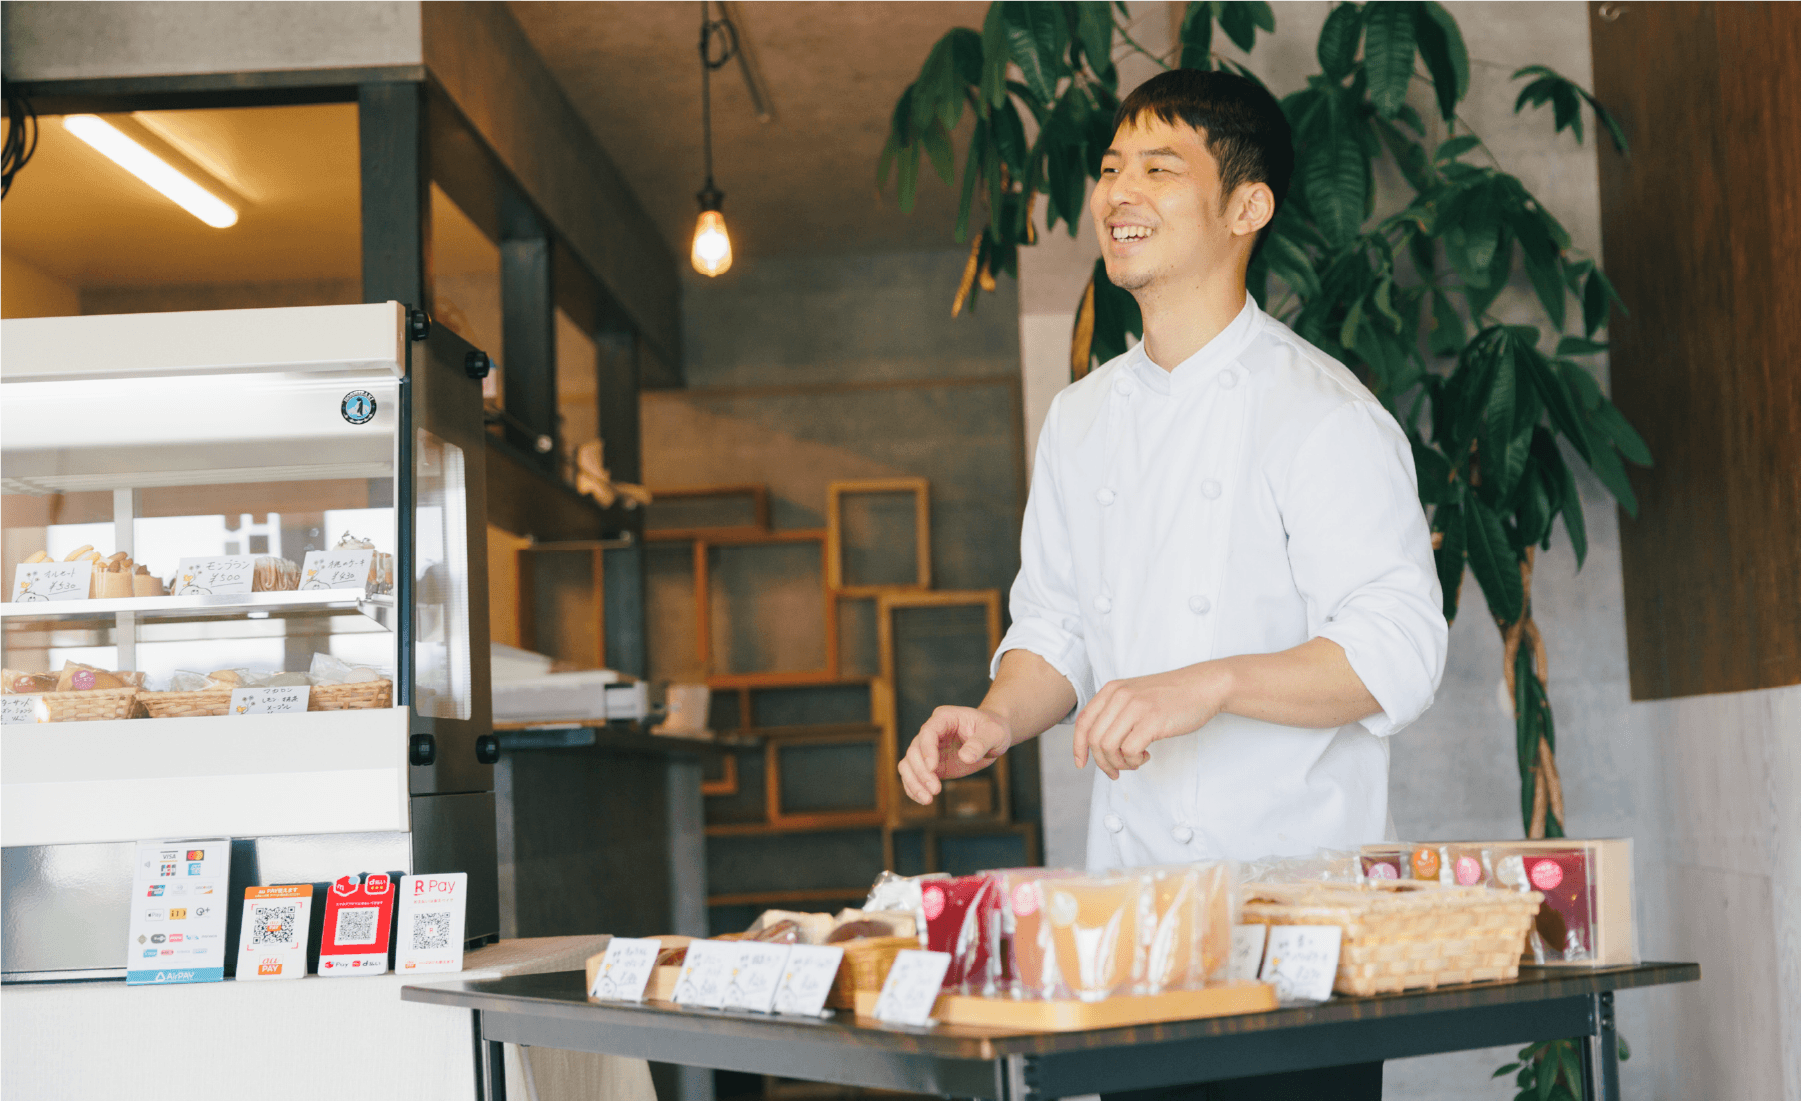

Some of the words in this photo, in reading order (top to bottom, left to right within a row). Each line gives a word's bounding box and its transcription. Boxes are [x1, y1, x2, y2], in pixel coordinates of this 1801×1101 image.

[206, 559, 250, 570] モンブラン
[429, 879, 456, 894] Pay
[262, 965, 279, 973] PAY
[167, 972, 195, 980] AirPAY
